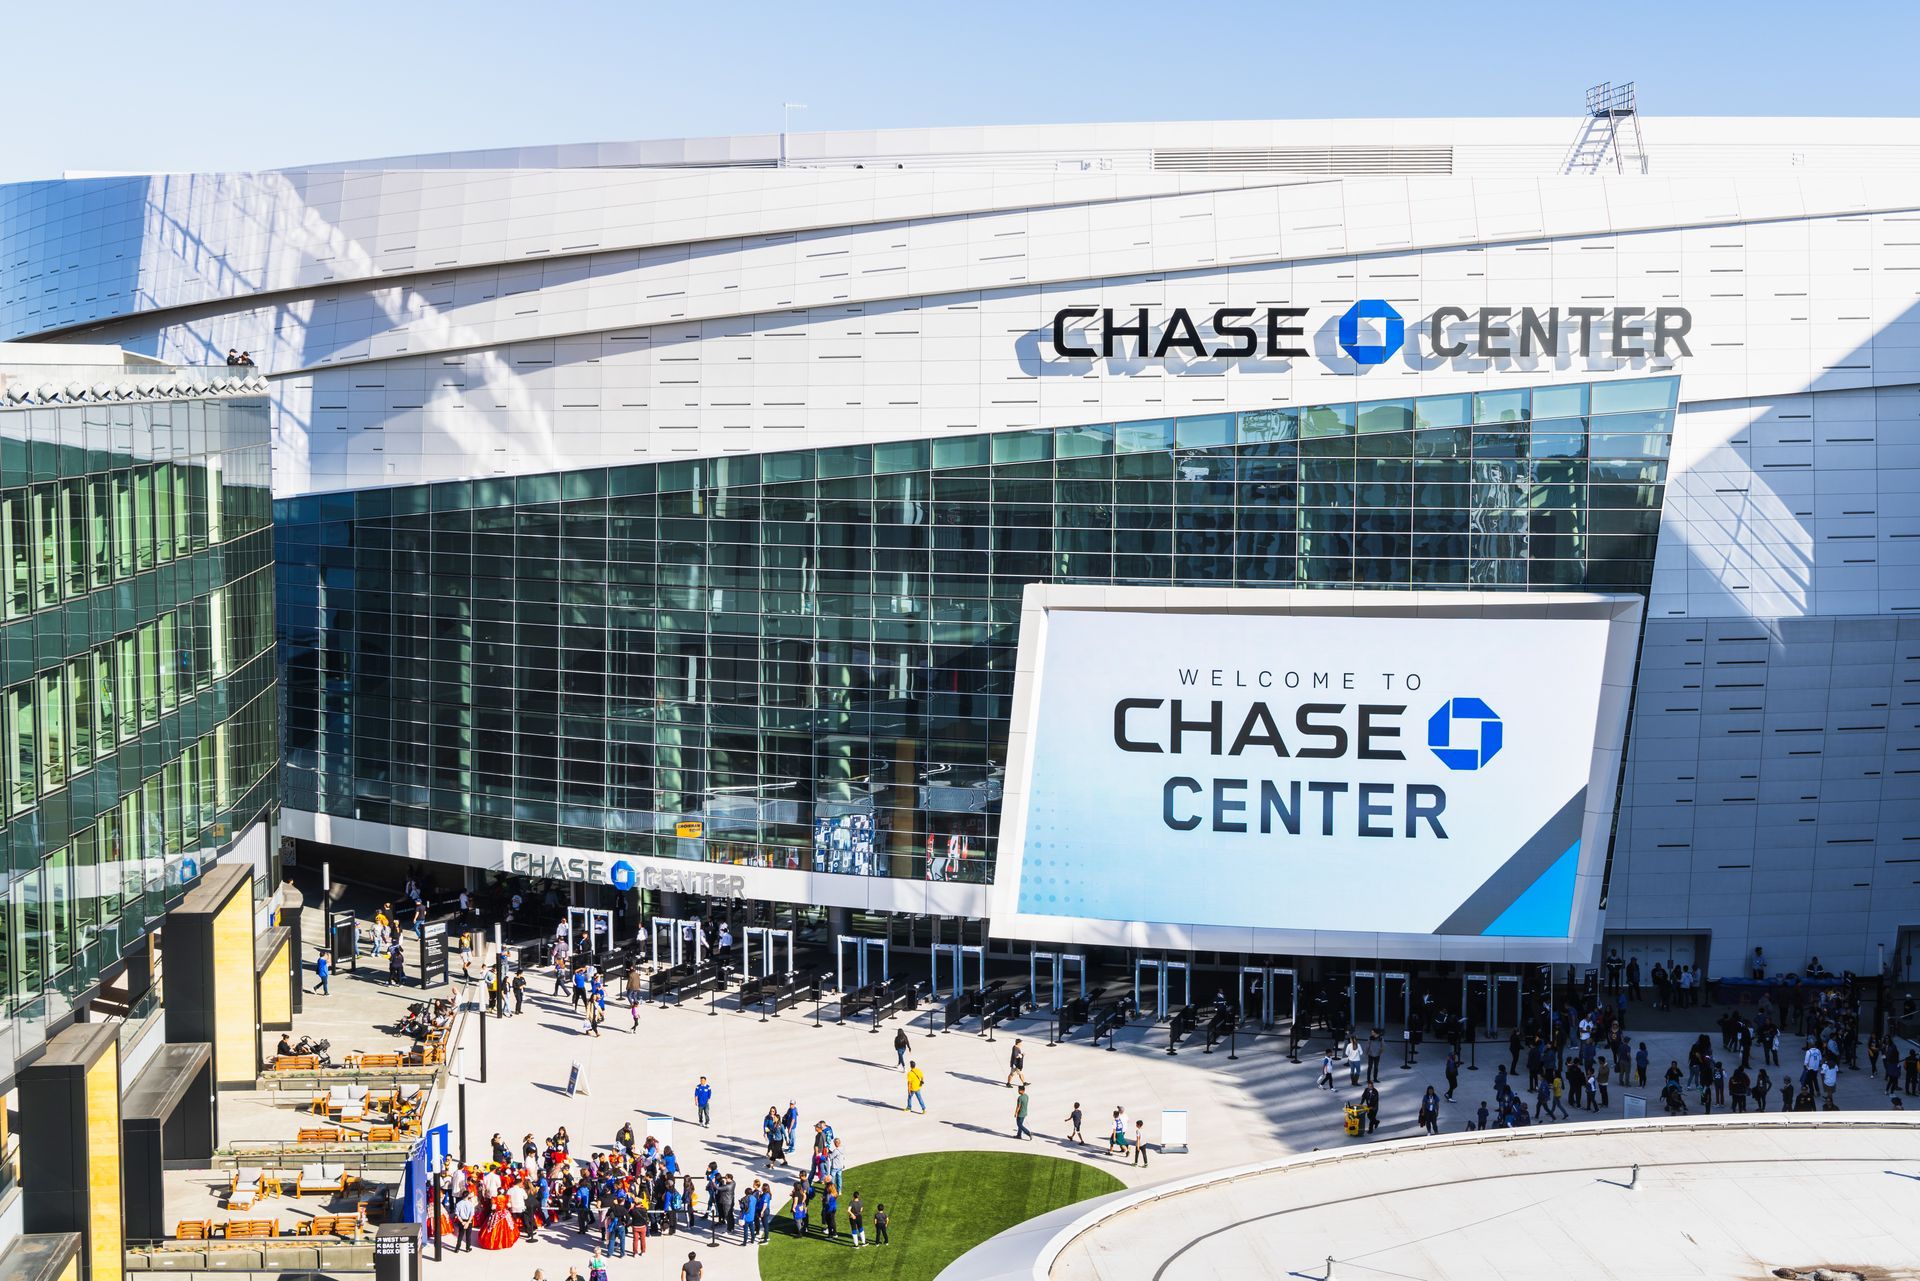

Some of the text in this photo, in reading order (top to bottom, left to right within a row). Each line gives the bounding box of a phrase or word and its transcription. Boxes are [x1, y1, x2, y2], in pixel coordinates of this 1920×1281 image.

[1054, 307, 1693, 358] CHASE CENTER
[1179, 669, 1421, 691] WELCOME TO
[1114, 698, 1407, 761] CHASE
[1163, 777, 1449, 840] CENTER
[511, 852, 746, 900] CHASE CENTER
